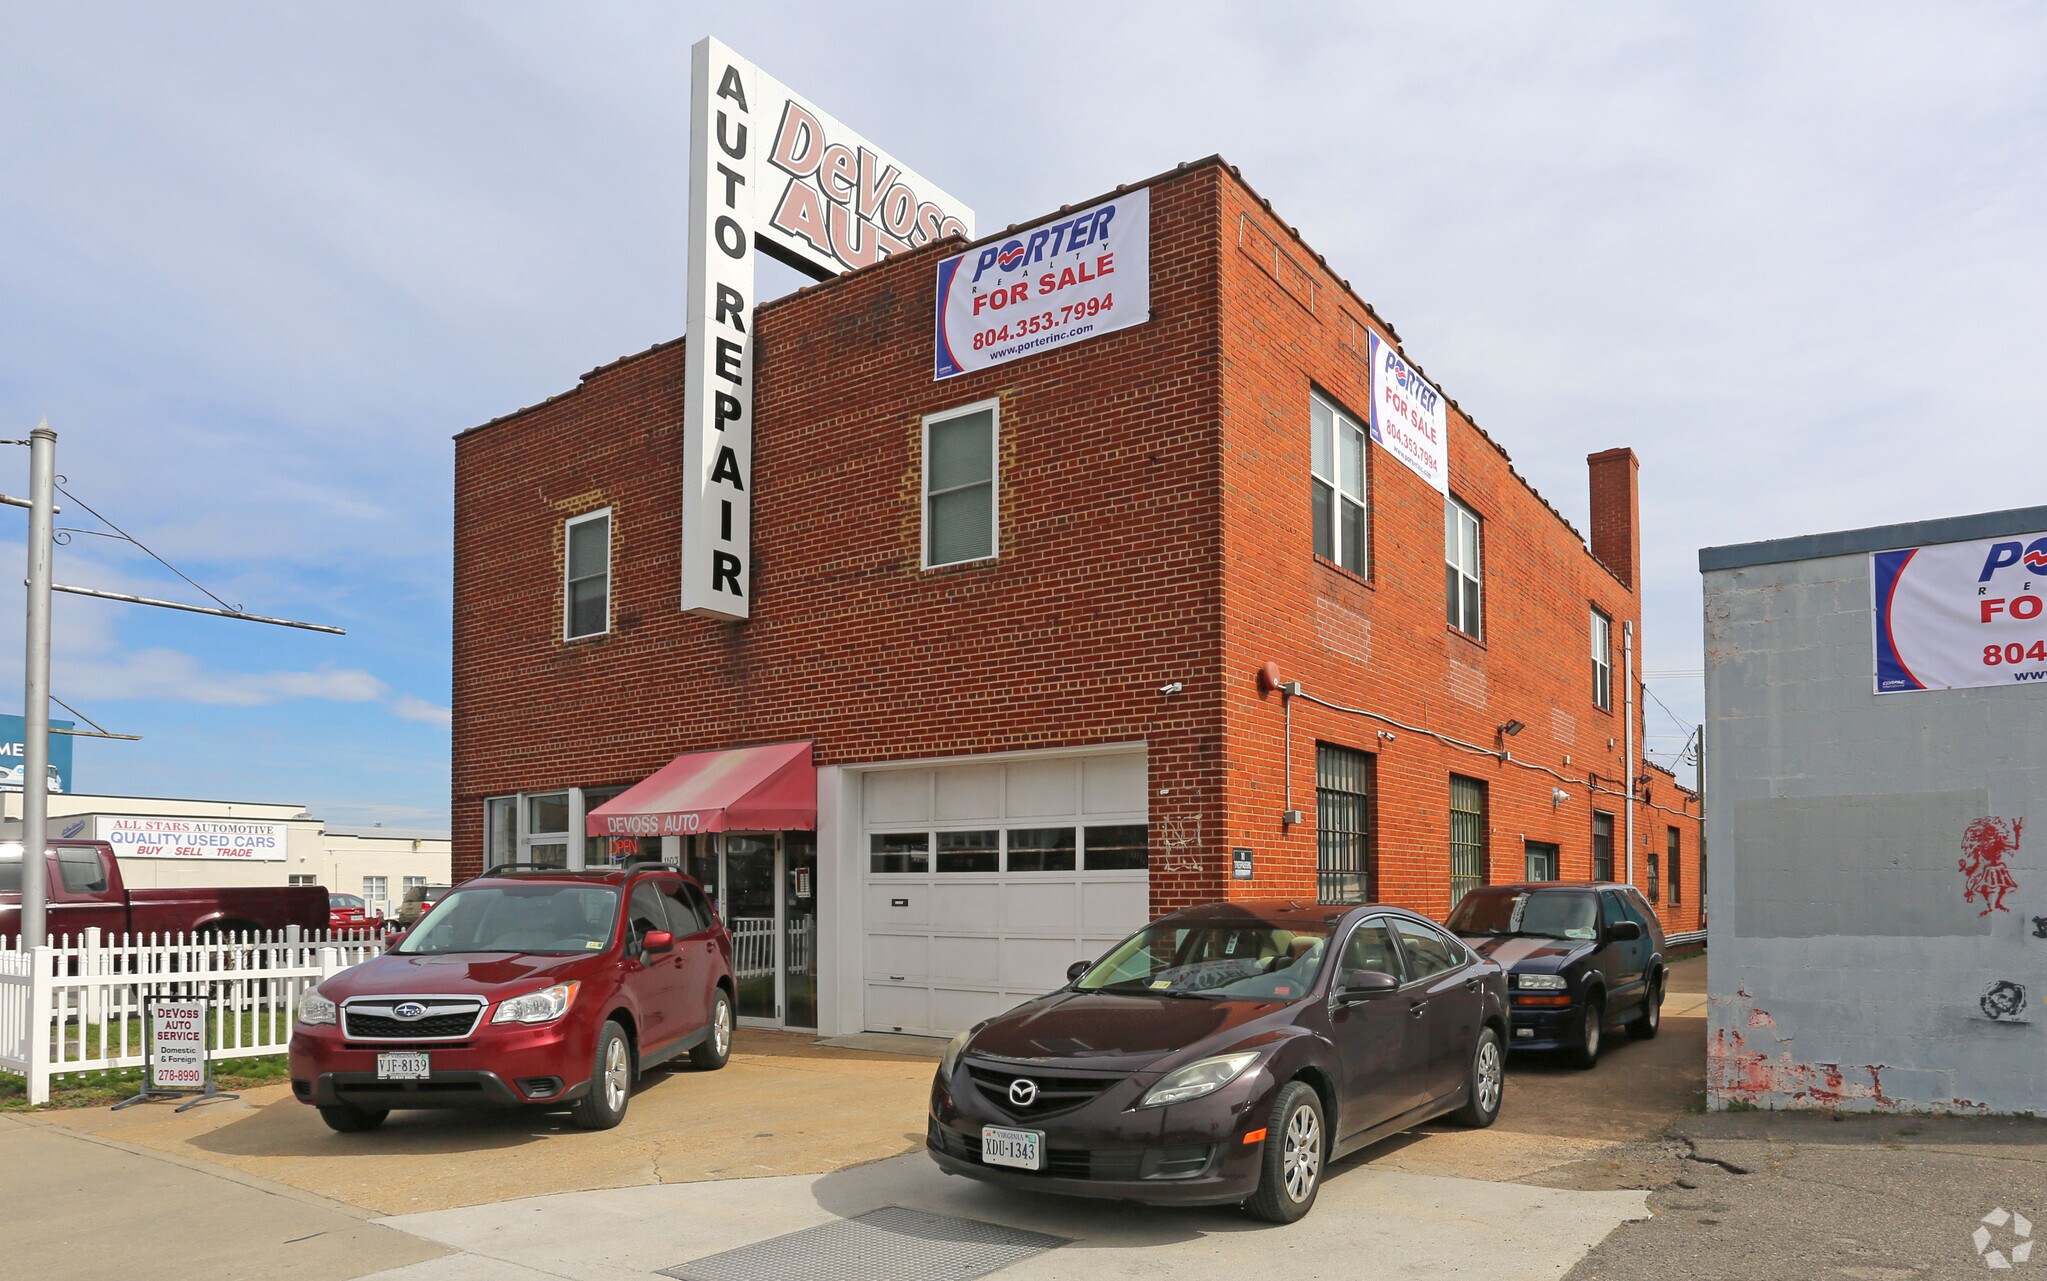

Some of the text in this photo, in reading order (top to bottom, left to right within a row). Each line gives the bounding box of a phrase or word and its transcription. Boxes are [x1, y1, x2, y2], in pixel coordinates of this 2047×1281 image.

[971, 205, 1116, 283] PORTER
[972, 252, 1115, 316] FOR SALE
[972, 292, 1114, 351] 804.353.7994
[711, 64, 749, 598] AUTO REPAIR
[990, 323, 1094, 360] www.porterinc.com
[1385, 351, 1438, 416] PORTER
[1385, 386, 1408, 420] FOR
[1411, 409, 1437, 446] SALE
[1386, 418, 1438, 473] 804.353.7994
[1980, 595, 2044, 623] FO
[113, 820, 274, 834] ALL STARS AUTOMOTIVE
[607, 813, 700, 833] DEVOSS AUTO
[110, 831, 275, 848] QUALITY USED CARS
[608, 838, 638, 855] OPEN
[136, 846, 253, 857] BUY SELL TRADE
[165, 1020, 191, 1030] AUTO
[157, 1031, 200, 1041] SERVICE
[160, 1046, 196, 1054] Domestic
[160, 1055, 197, 1064] & Foreign
[379, 1059, 427, 1072] VJF-8139
[158, 1069, 200, 1081] 278-8990
[997, 1131, 1023, 1140] VIRGINIA
[985, 1138, 1035, 1160] XDU-1343
